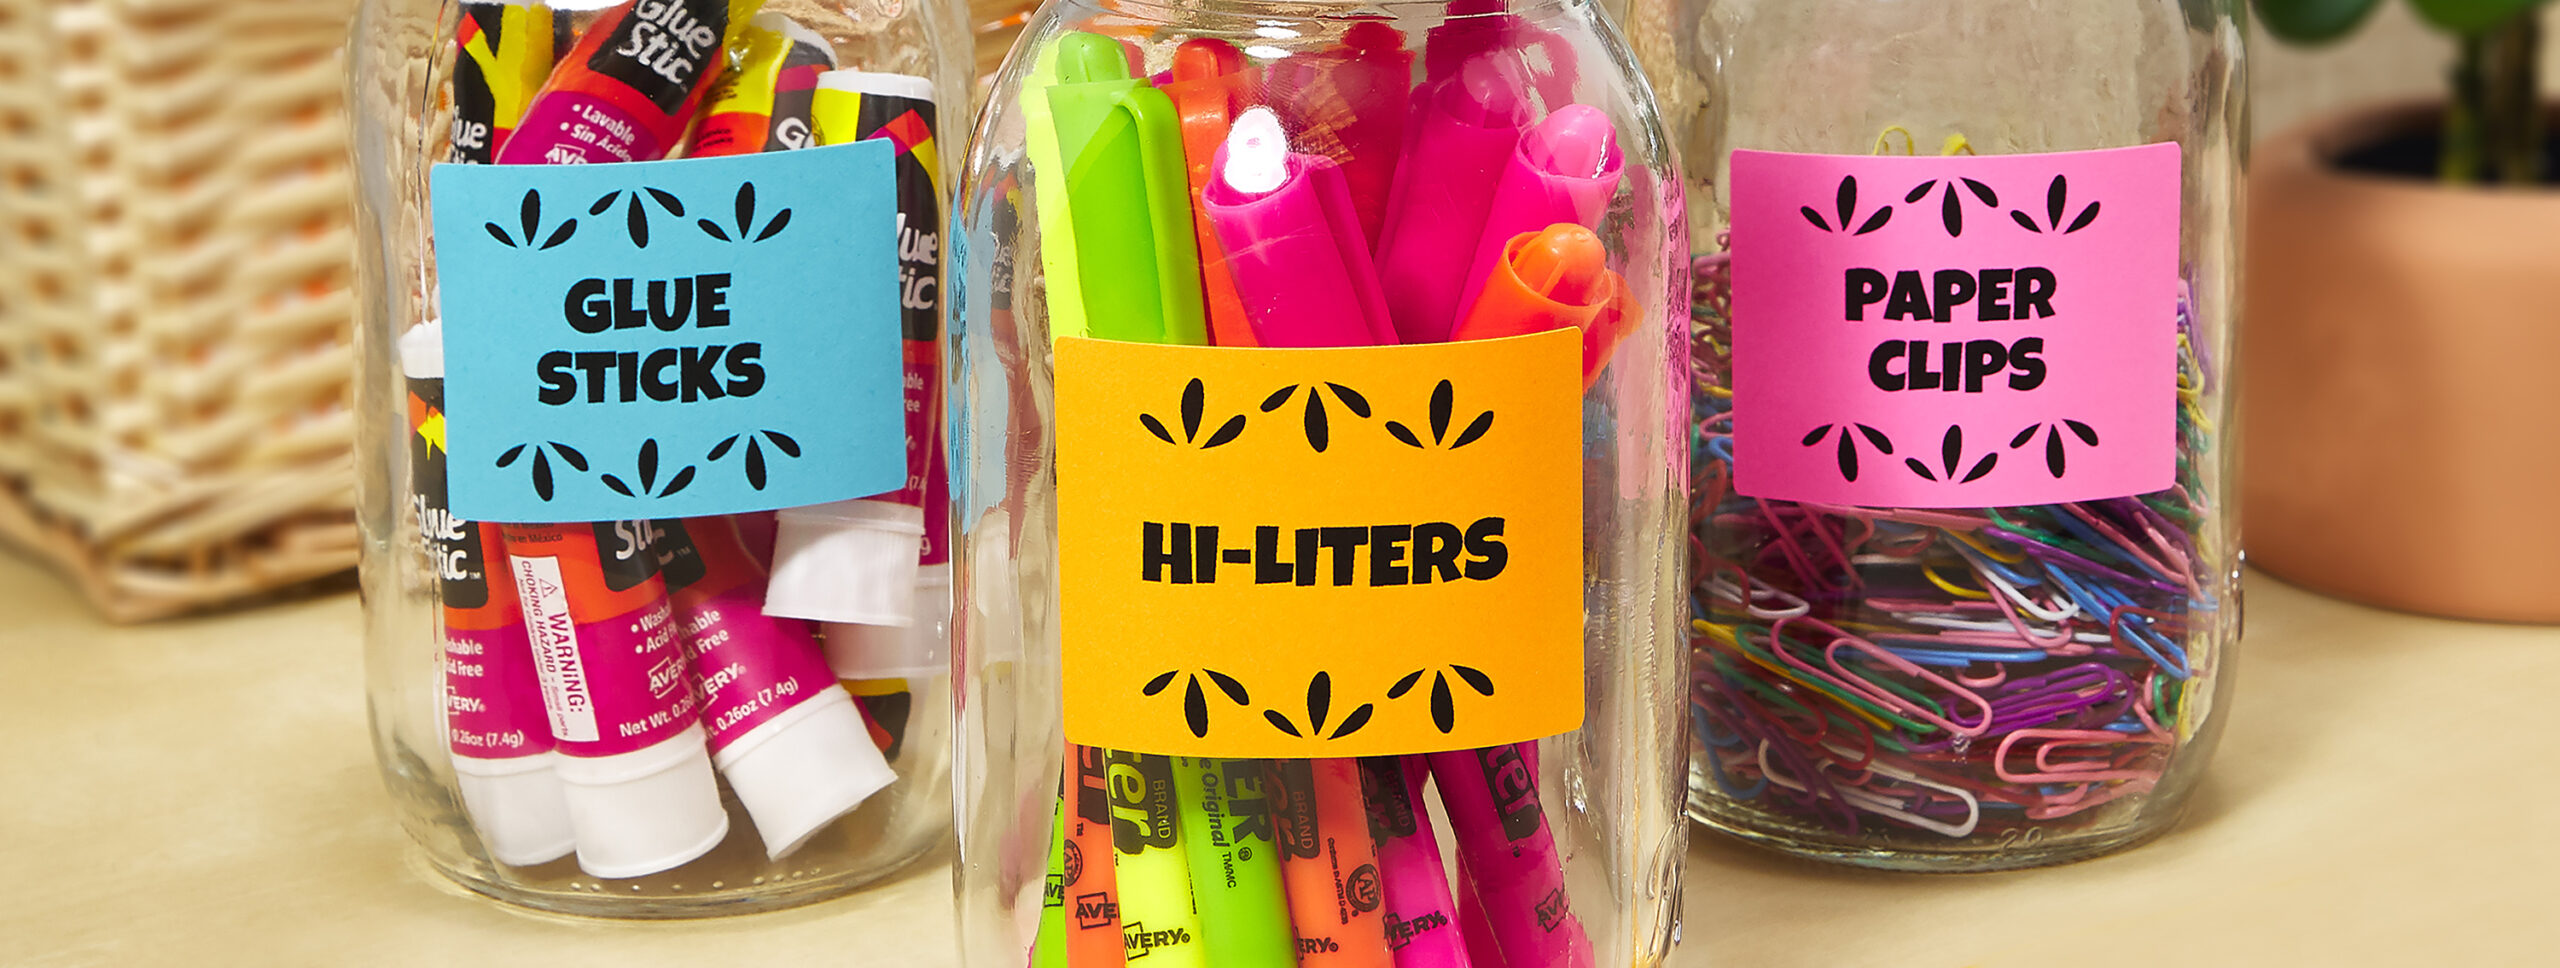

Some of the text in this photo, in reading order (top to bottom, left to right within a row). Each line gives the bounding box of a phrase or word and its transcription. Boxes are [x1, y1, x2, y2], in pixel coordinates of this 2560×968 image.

[615, 20, 694, 84] Stic
[570, 123, 598, 145] Sin
[581, 104, 636, 147] Lavable
[564, 272, 732, 334] GLUE
[1844, 265, 2057, 323] PAPER
[536, 342, 766, 406] STICKS
[1868, 337, 2047, 393] CLIPS
[1142, 516, 1509, 587] HI-LITERS
[521, 560, 544, 617] CHOKING
[535, 621, 557, 673] HAZARD
[646, 626, 669, 653] Acid
[696, 629, 729, 655] Free
[548, 611, 586, 713] WARNING:
[618, 719, 649, 738] Net
[648, 711, 672, 729] Wt.
[716, 700, 760, 731] 0.26oz
[758, 676, 799, 707] (7.4g)
[486, 729, 524, 748] (7.4g)
[1153, 779, 1171, 839] BRAND
[1202, 772, 1231, 848] Original
[1293, 790, 1315, 849] BRAND
